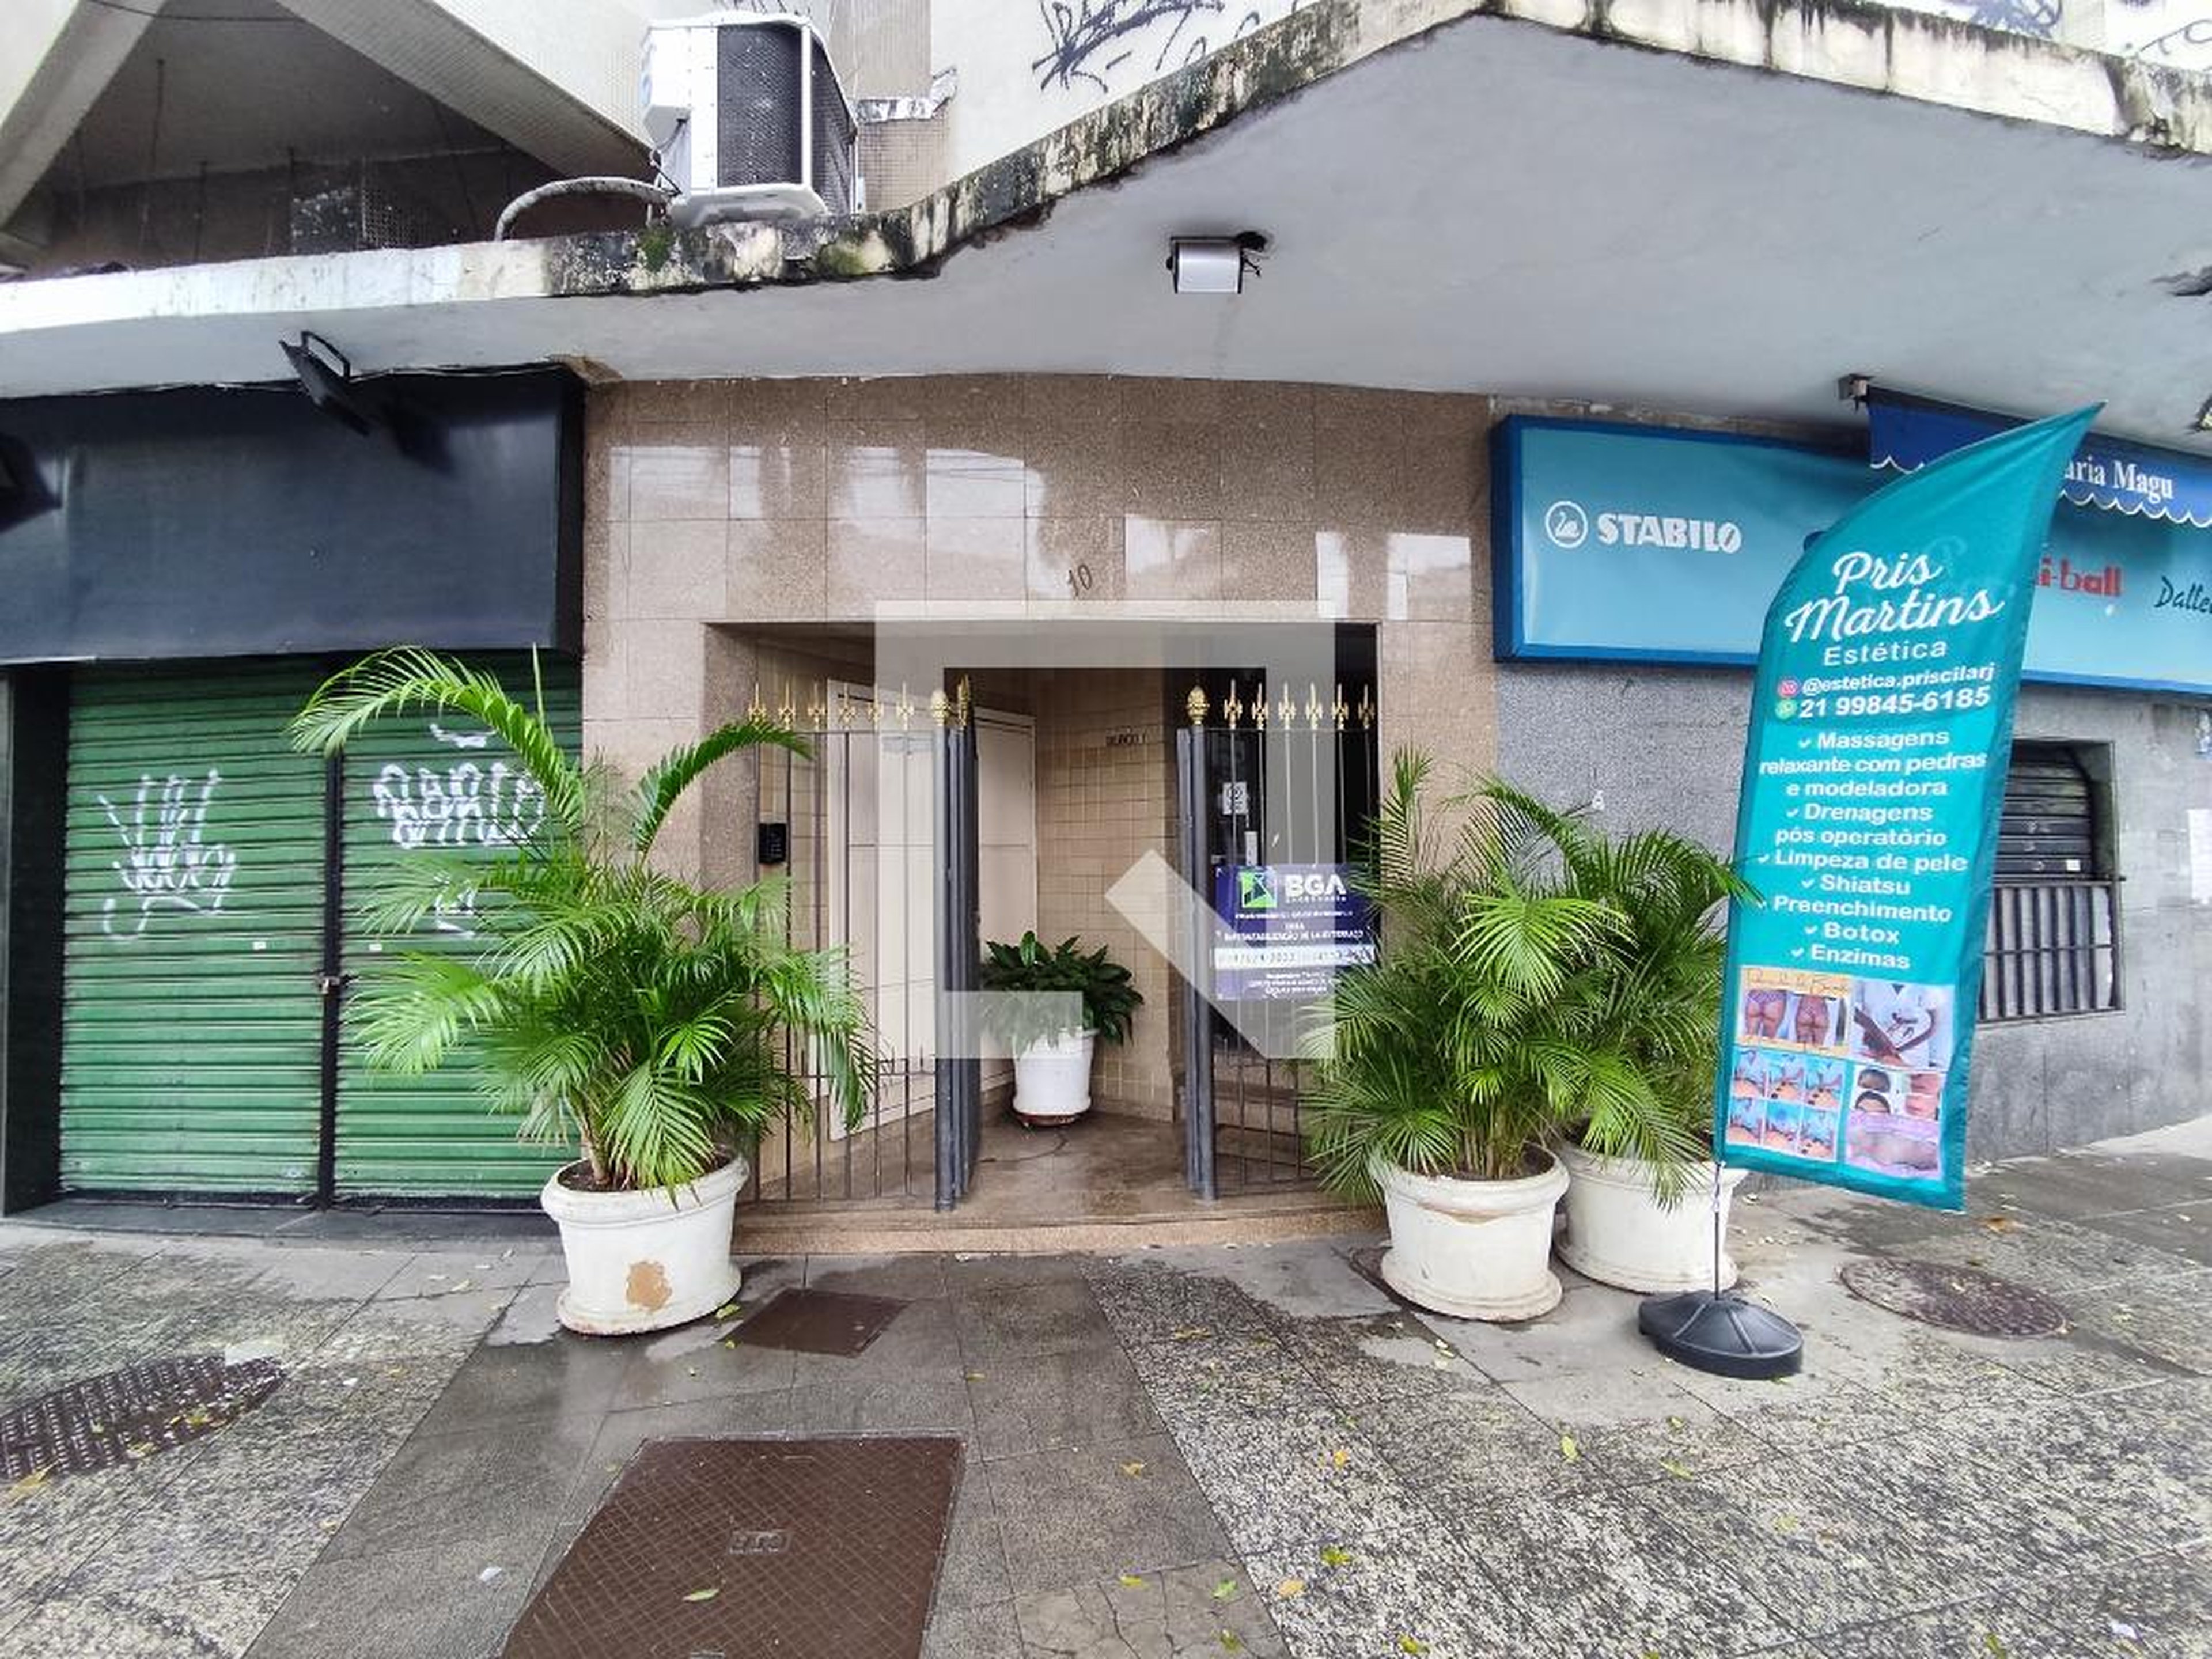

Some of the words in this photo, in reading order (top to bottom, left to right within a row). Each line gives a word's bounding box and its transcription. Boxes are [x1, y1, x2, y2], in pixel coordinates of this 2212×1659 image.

[2113, 459, 2174, 505] Magu
[1597, 513, 1742, 554] STABILO
[1832, 551, 1944, 596] Pris
[2036, 555, 2122, 597] i-ball
[1784, 588, 2005, 643] Martins
[1823, 640, 1948, 667] Estética
[1799, 698, 1827, 719] 21
[1835, 685, 1991, 717] 99845-6185
[1818, 731, 1950, 751] Massagens
[1759, 756, 1851, 774] relaxante
[1855, 757, 1900, 773] com
[1905, 752, 1988, 775] pedras
[1787, 783, 1800, 796] e
[1805, 780, 1949, 797] modeladora
[1804, 803, 1934, 825] Drenagens
[1775, 827, 1815, 846] pós
[1820, 828, 1948, 847] operatório
[1775, 849, 1869, 870] Limpeza
[1877, 853, 1908, 870] de
[1914, 854, 1969, 874] pele
[1285, 874, 1347, 897] BGA
[1820, 874, 1911, 895] Shiatsu
[1774, 895, 1953, 923] Preenchimento
[1823, 921, 1901, 945] Botox
[1810, 944, 1911, 969] Enzimas
